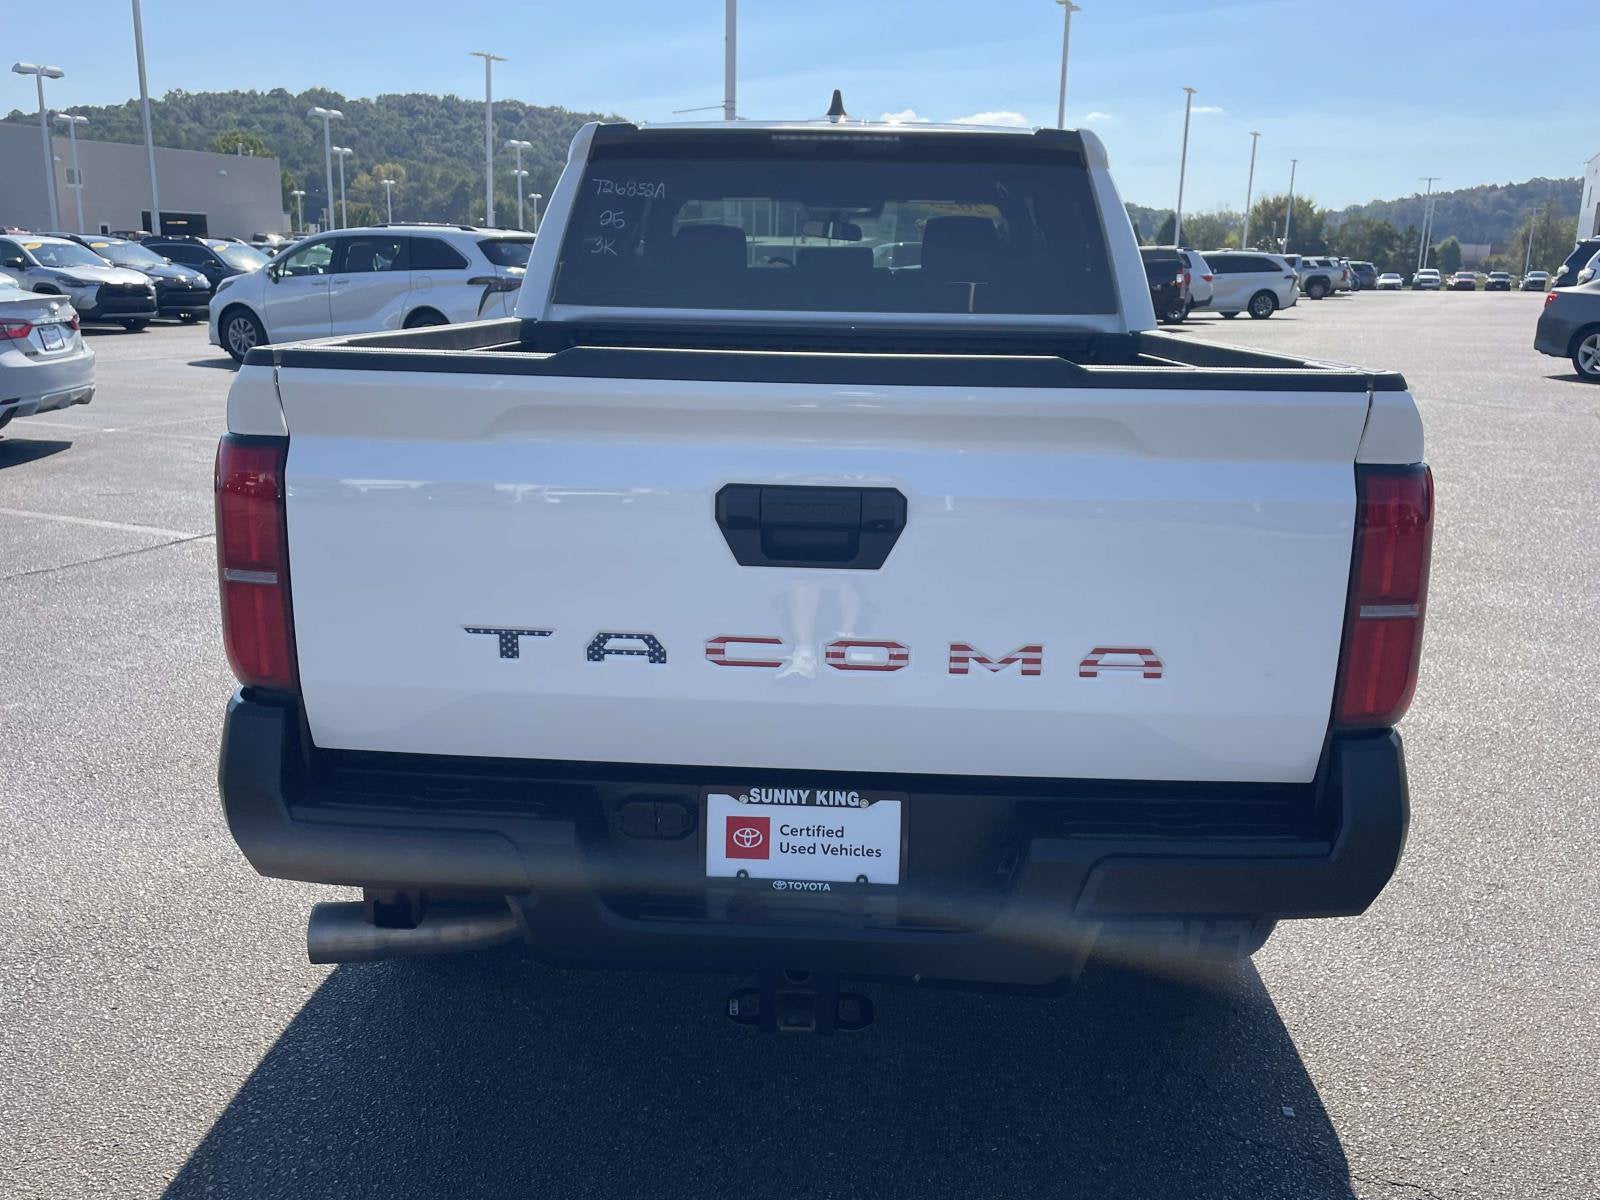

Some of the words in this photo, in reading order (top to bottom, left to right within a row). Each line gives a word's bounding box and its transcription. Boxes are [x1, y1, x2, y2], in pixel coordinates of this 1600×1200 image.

[463, 627, 1163, 679] TACOMA
[750, 787, 810, 805] SUNNY
[816, 790, 860, 807] KING
[779, 824, 844, 838] Certified
[779, 842, 816, 855] Used
[821, 844, 882, 858] Vehicles
[787, 881, 831, 892] TOYOTA
